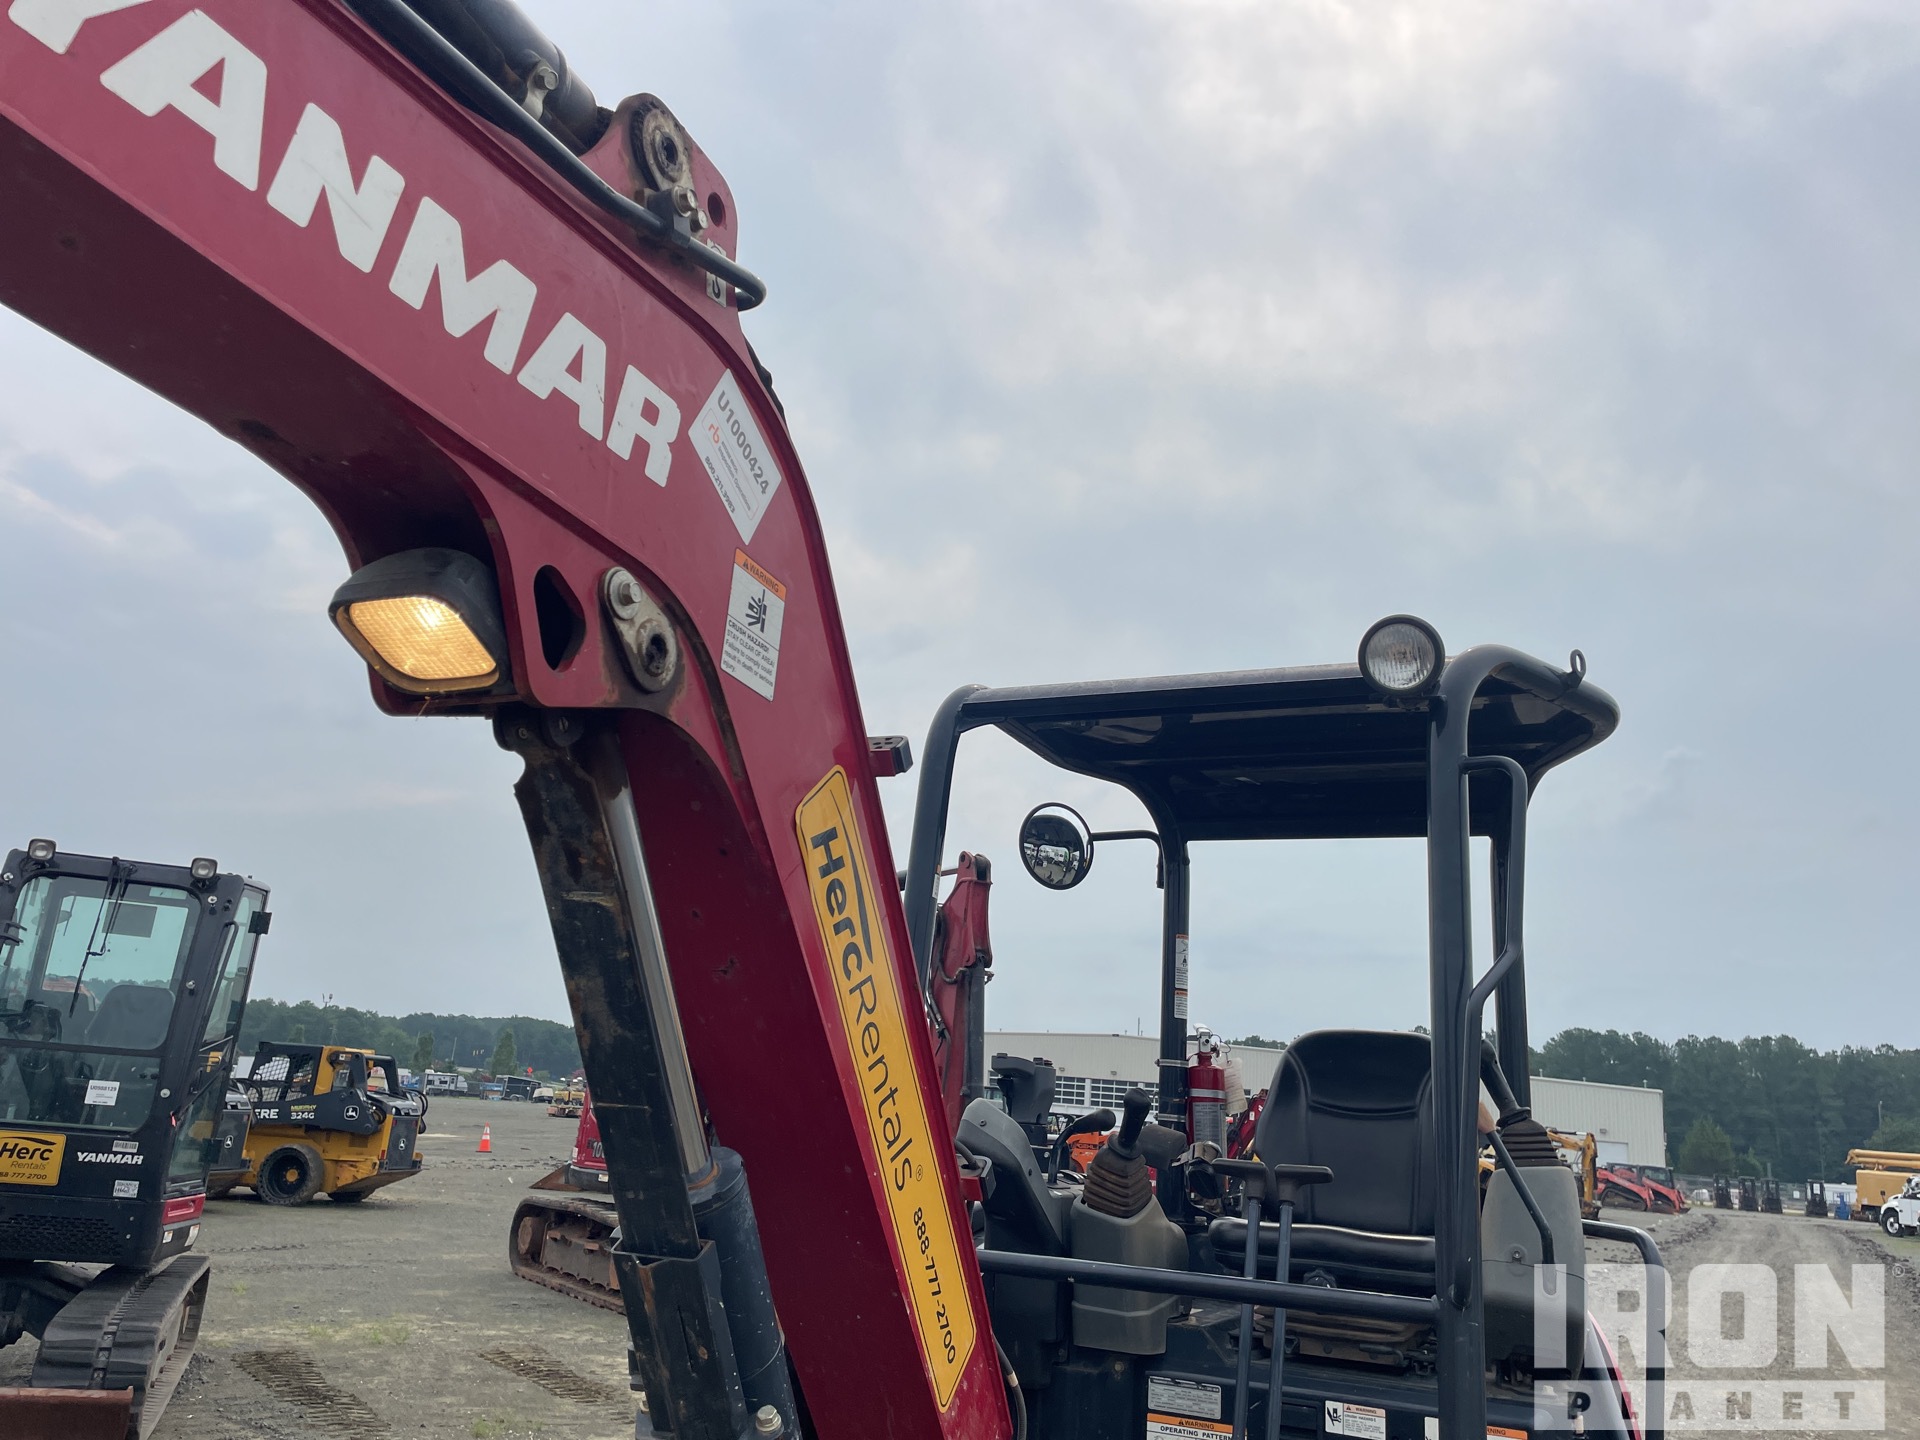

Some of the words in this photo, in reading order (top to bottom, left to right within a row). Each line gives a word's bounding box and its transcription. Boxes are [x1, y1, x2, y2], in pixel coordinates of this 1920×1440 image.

[717, 390, 770, 495] U1000424
[749, 563, 779, 593] WARNING
[728, 619, 746, 637] CRUSH
[726, 629, 738, 642] STAY
[739, 637, 754, 653] CLEAR
[754, 648, 761, 658] OF
[725, 638, 739, 653] Failure
[745, 653, 760, 669] comply
[760, 663, 772, 676] could
[741, 660, 753, 673] death
[758, 672, 773, 687] serious
[0, 1142, 53, 1161] Herc
[77, 1152, 143, 1165] YANMAR
[10, 1160, 46, 1170] Rentals
[913, 1206, 956, 1365] 888-777-2700
[1355, 1407, 1377, 1415] WARNING
[1160, 1425, 1199, 1437] OPERATING
[1184, 1420, 1215, 1430] WARNING
